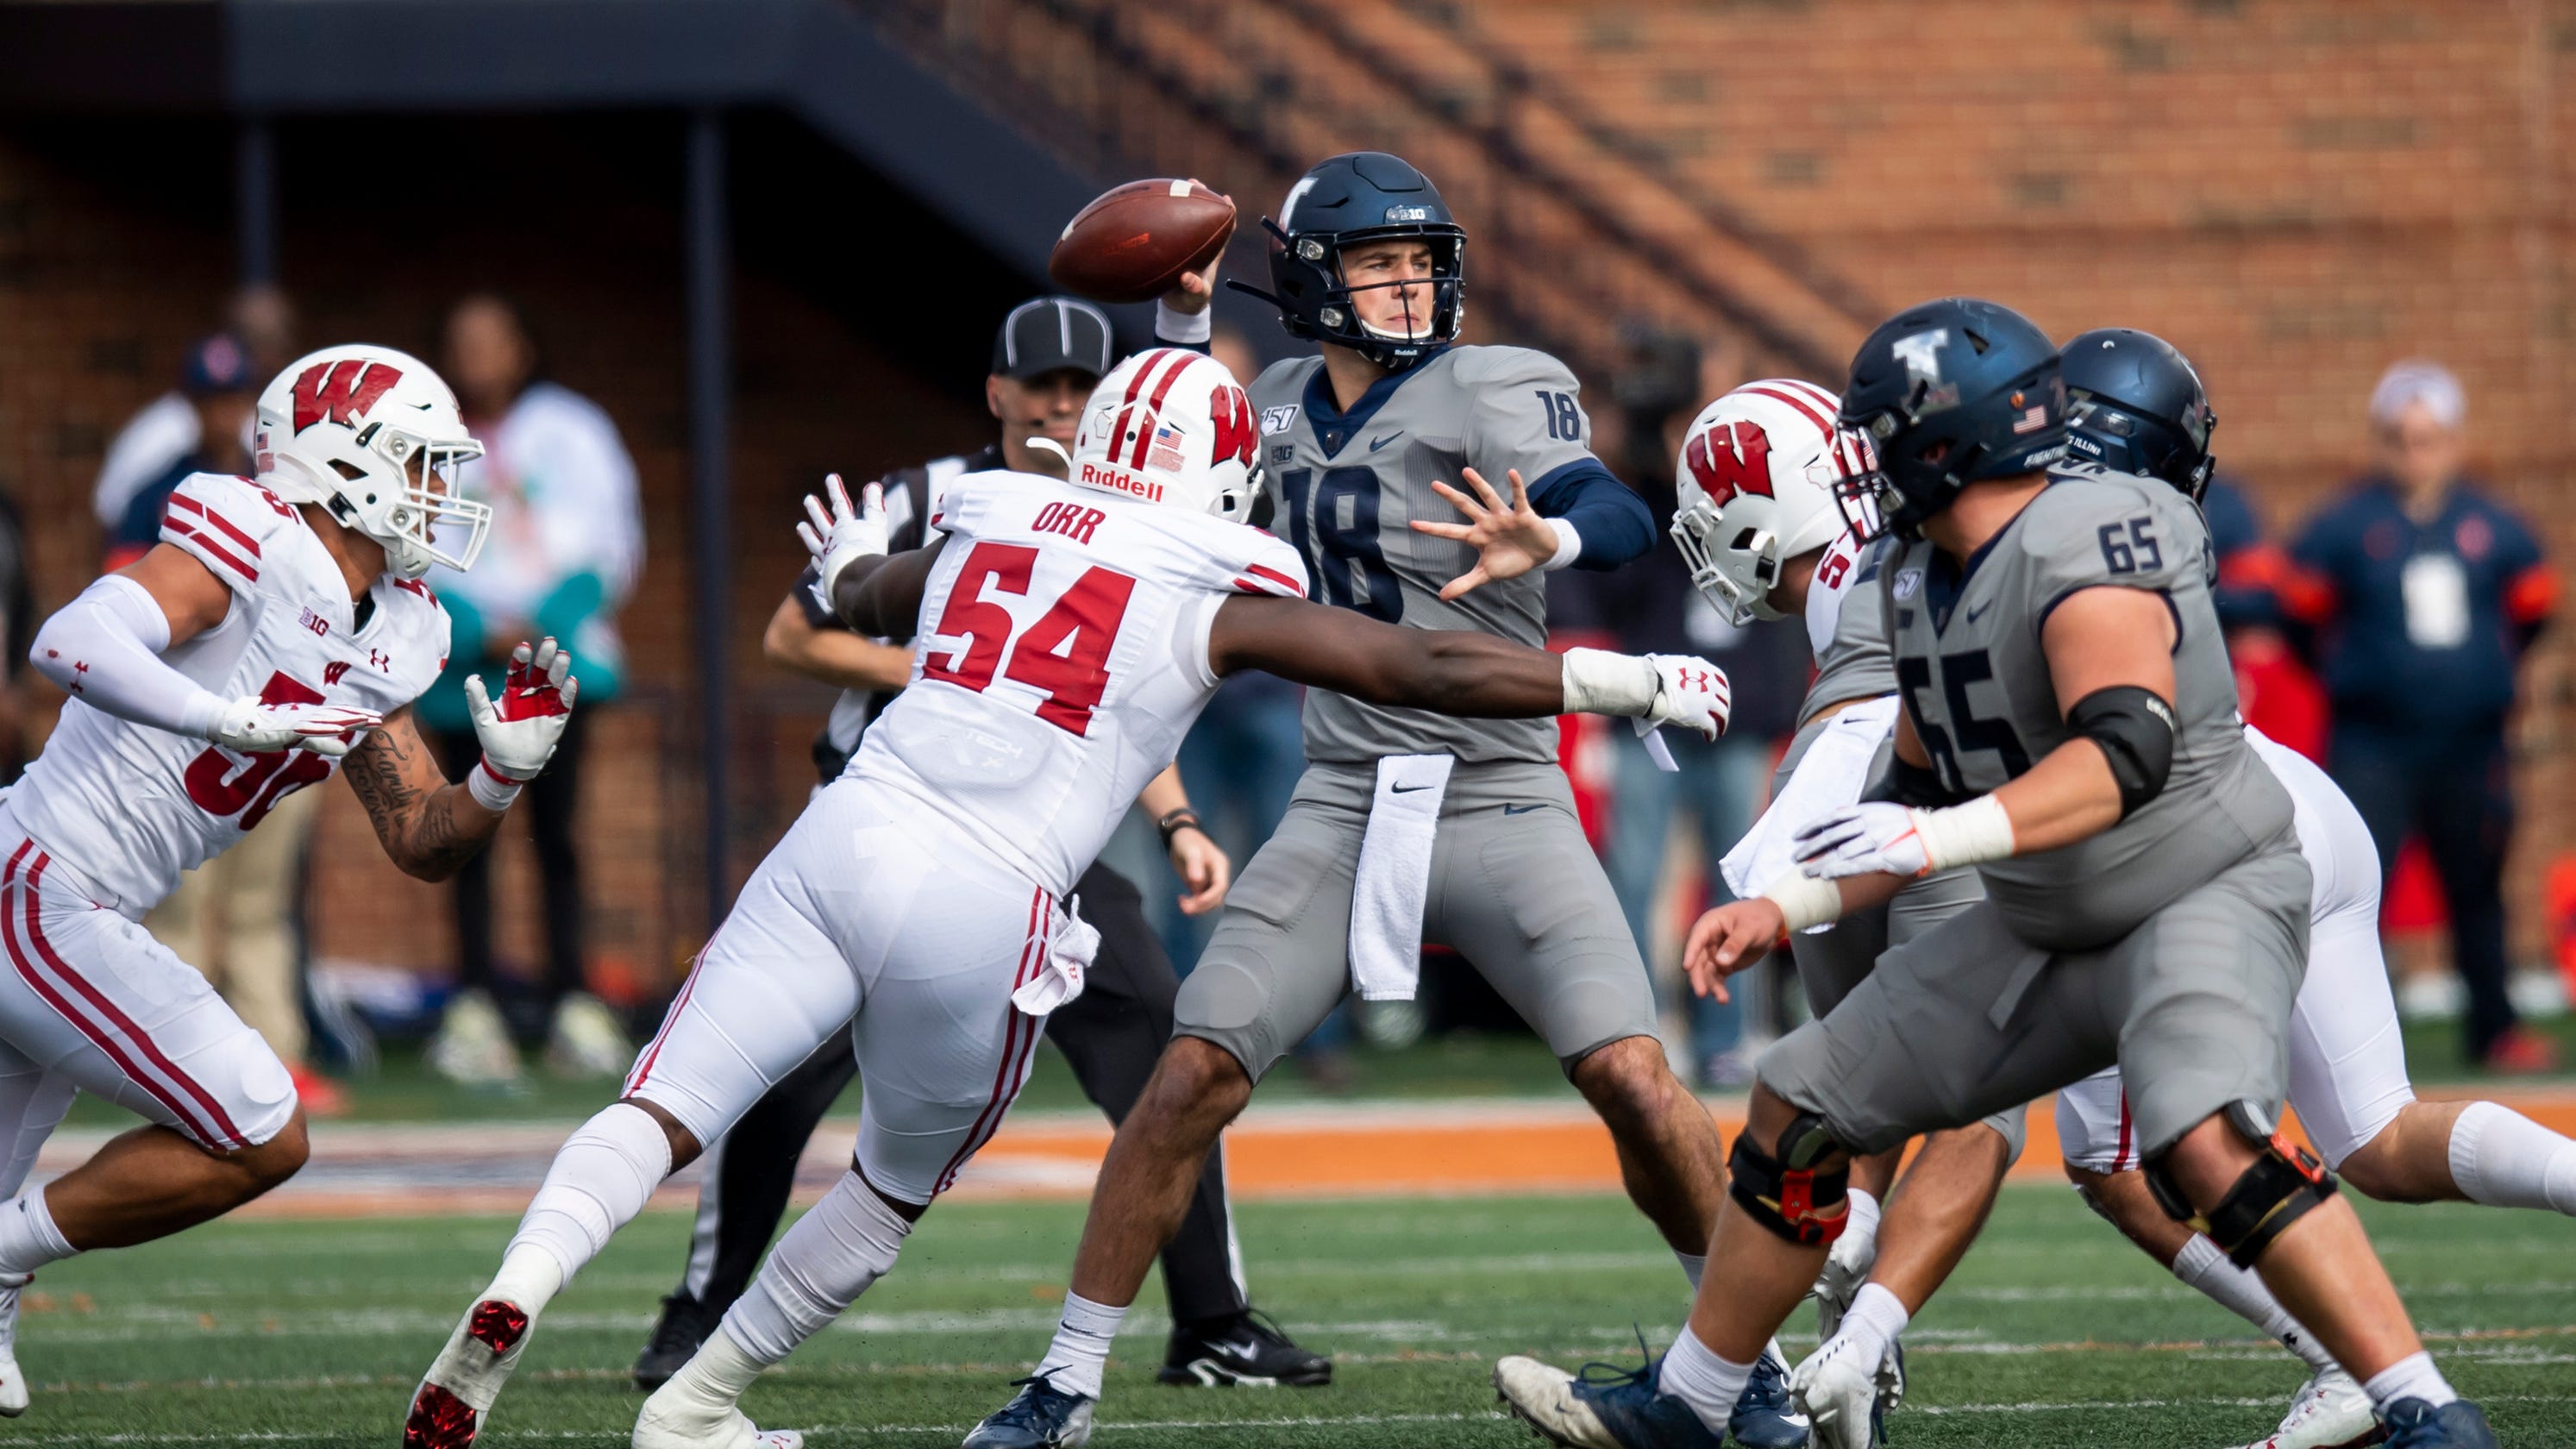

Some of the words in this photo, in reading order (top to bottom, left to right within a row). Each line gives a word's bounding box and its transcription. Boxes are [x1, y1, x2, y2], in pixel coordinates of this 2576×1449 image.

[1536, 391, 1580, 442] 18
[1081, 463, 1163, 503] Riddell
[1031, 501, 1106, 545] ORR
[1282, 465, 1404, 624] 18
[2098, 518, 2163, 575] 65
[922, 542, 1136, 737] 54
[1900, 649, 2032, 795] 65
